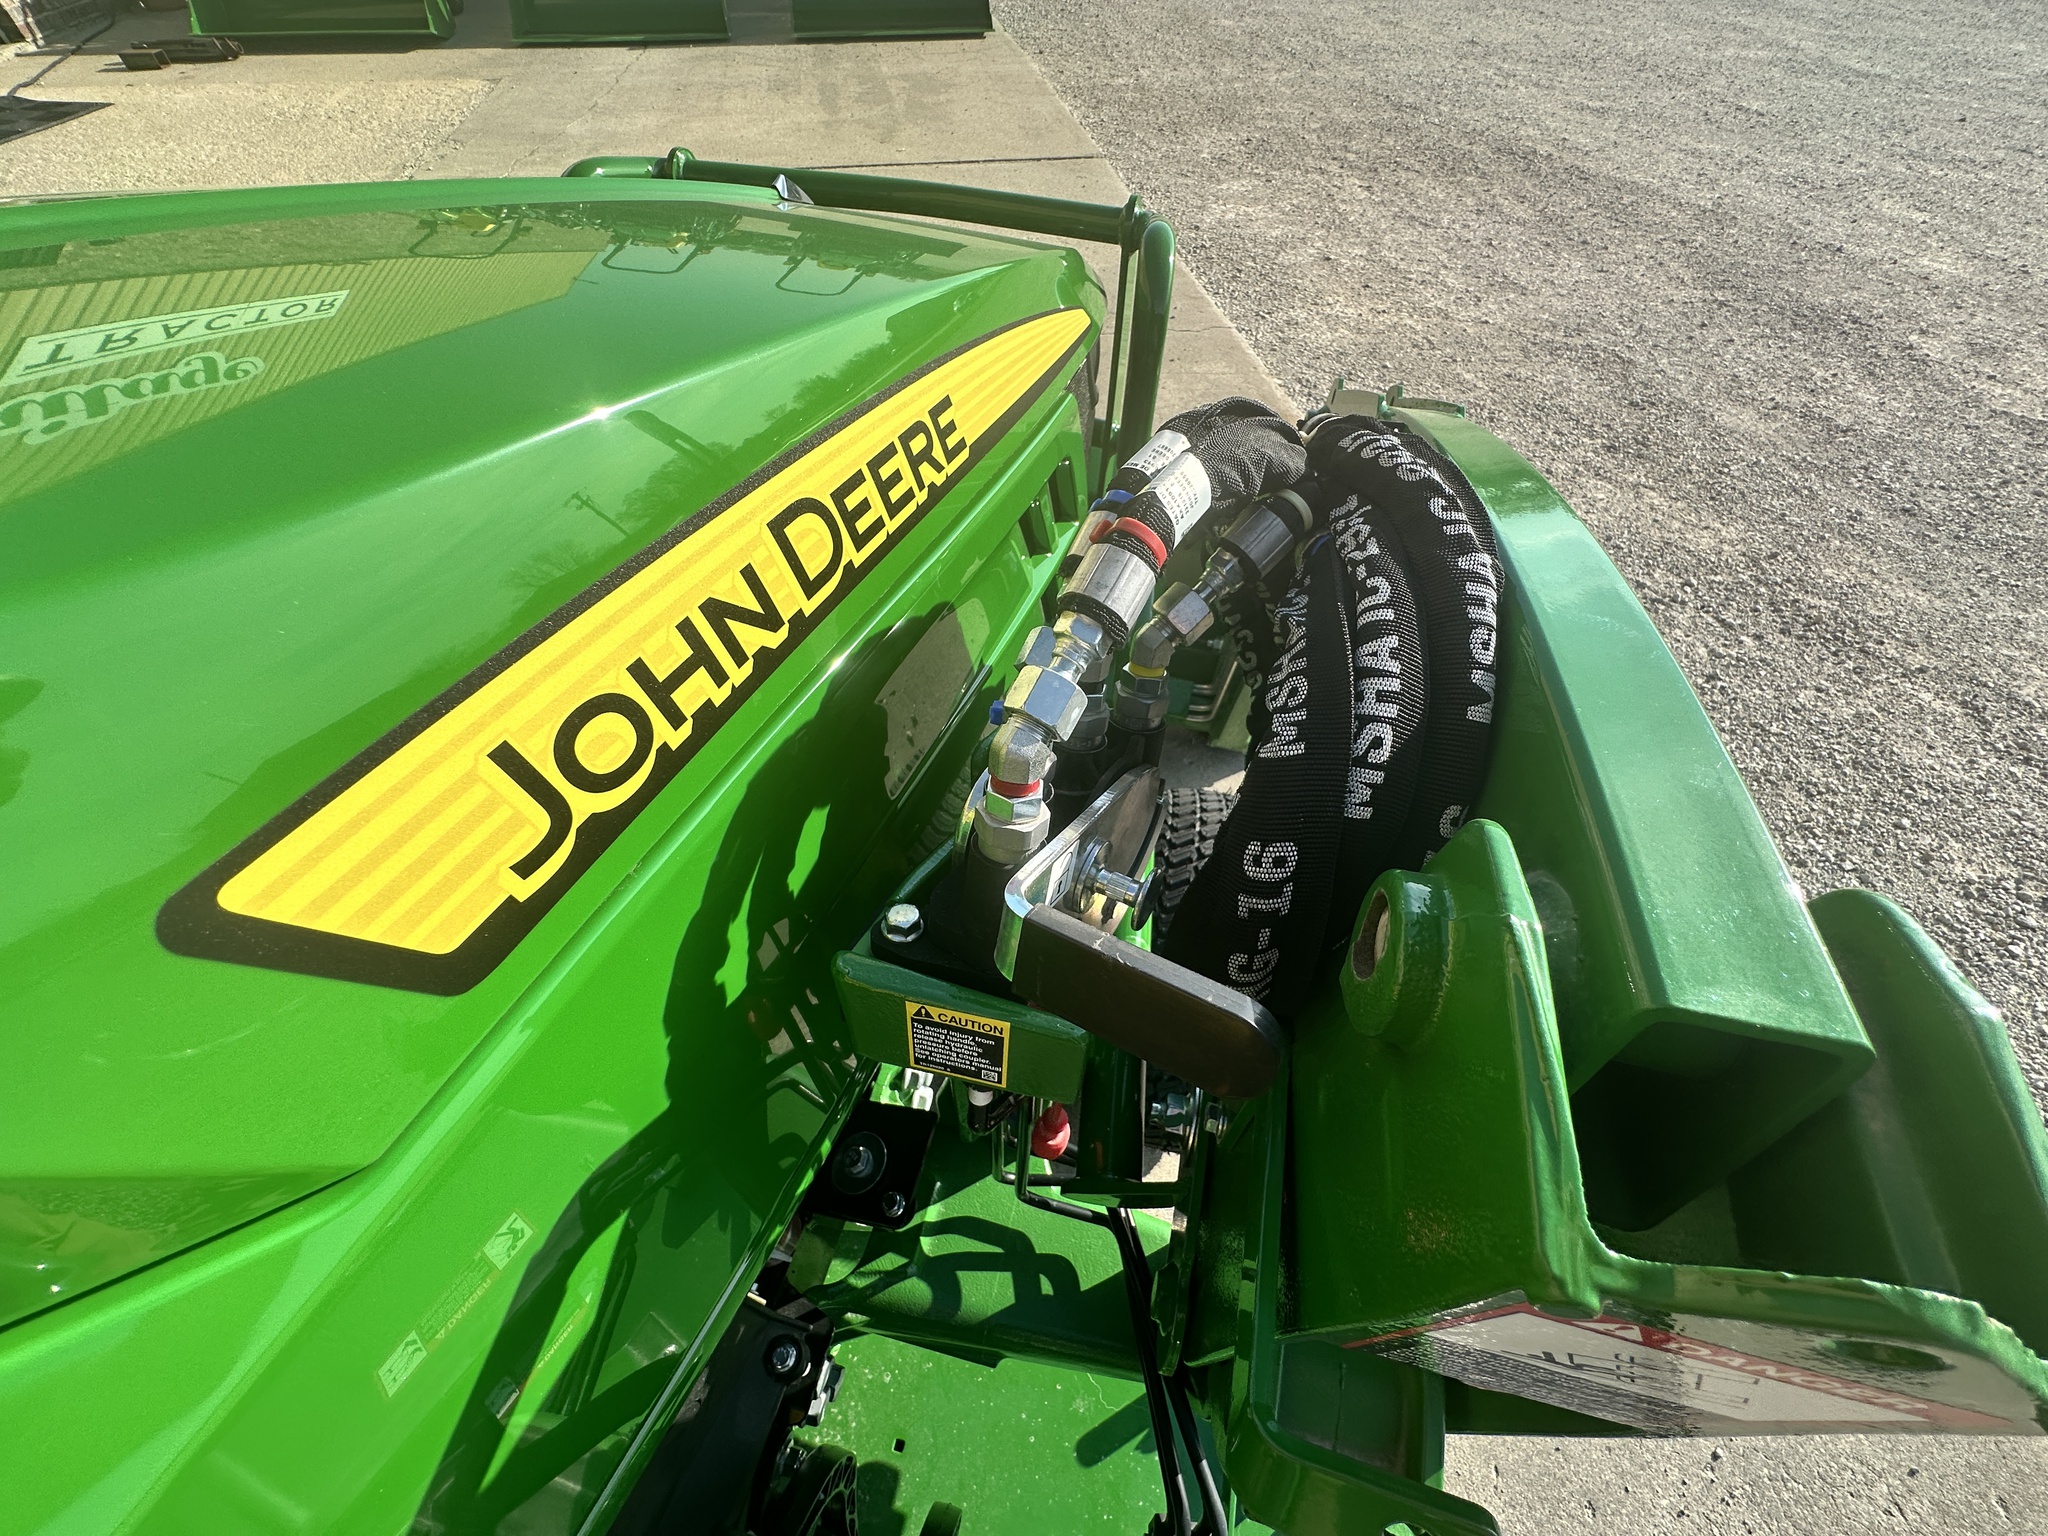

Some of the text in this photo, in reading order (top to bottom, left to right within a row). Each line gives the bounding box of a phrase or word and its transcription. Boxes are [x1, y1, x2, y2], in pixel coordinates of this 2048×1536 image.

[486, 394, 969, 882] JOHN DEERE
[1343, 634, 1401, 819] MSHA
[913, 1028, 945, 1039] rotating
[938, 1013, 1003, 1035] CAUTION
[913, 1033, 983, 1053] release hydraulic
[925, 1025, 947, 1034] avoid
[949, 1030, 973, 1041] injury
[975, 1036, 995, 1045] from
[914, 1038, 978, 1057] pressure before
[914, 1044, 992, 1065] unlatching coupler.
[914, 1047, 1002, 1072] See operators manual
[928, 1055, 978, 1072] instructions.
